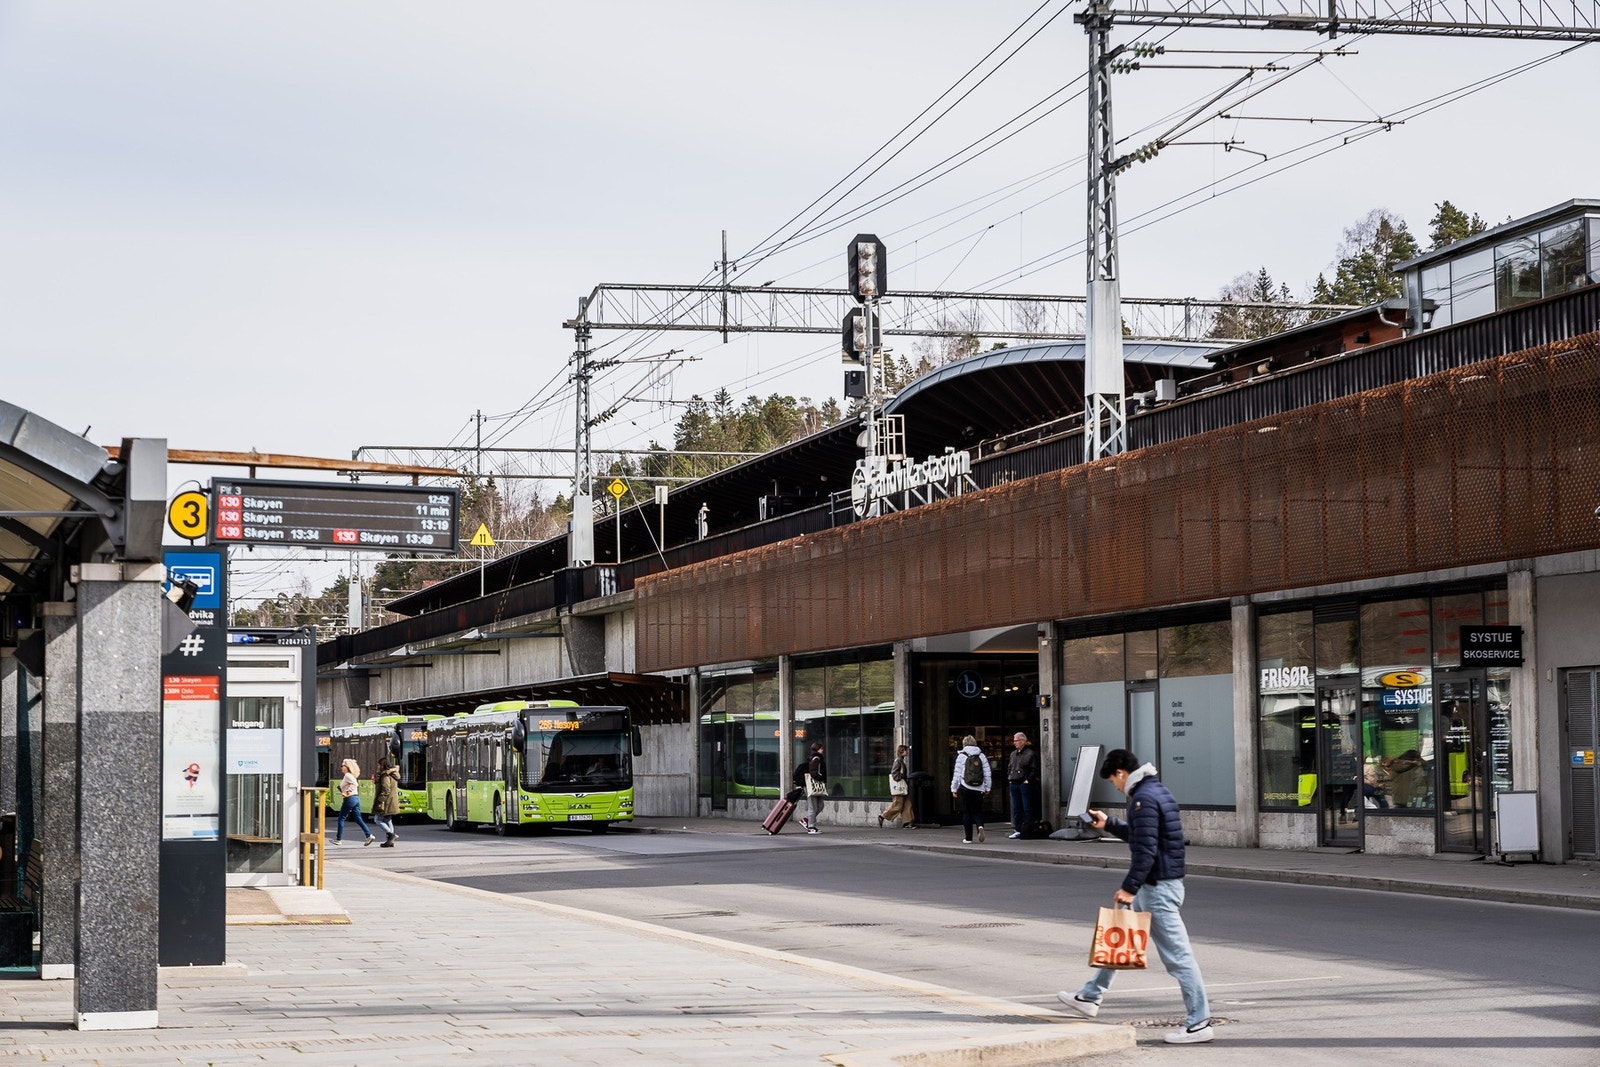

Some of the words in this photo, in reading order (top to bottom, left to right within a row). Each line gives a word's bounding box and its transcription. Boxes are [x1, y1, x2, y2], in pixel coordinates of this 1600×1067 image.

[922, 446, 972, 487] stasjon
[235, 486, 242, 495] 3
[220, 497, 239, 507] 130
[243, 497, 283, 510] Skøyen
[183, 500, 200, 528] 3
[416, 505, 428, 515] 11
[430, 506, 449, 516] min
[220, 511, 239, 522] 130
[243, 512, 282, 525] Skøyen
[421, 519, 449, 531] 13:19
[221, 526, 240, 537] 130
[243, 527, 284, 540] Skøyen
[290, 529, 319, 540] 13:34
[336, 531, 356, 541] 130
[360, 532, 399, 545] Skøyen
[405, 533, 434, 545] 13:49
[479, 533, 486, 543] 11
[188, 609, 214, 619] dvika
[1469, 632, 1513, 643] SYSTUE
[1463, 650, 1521, 659] SKOSERVICE
[1261, 665, 1310, 689] FRISØR
[1394, 688, 1433, 705] SYSTUE
[232, 719, 265, 729] Inngang
